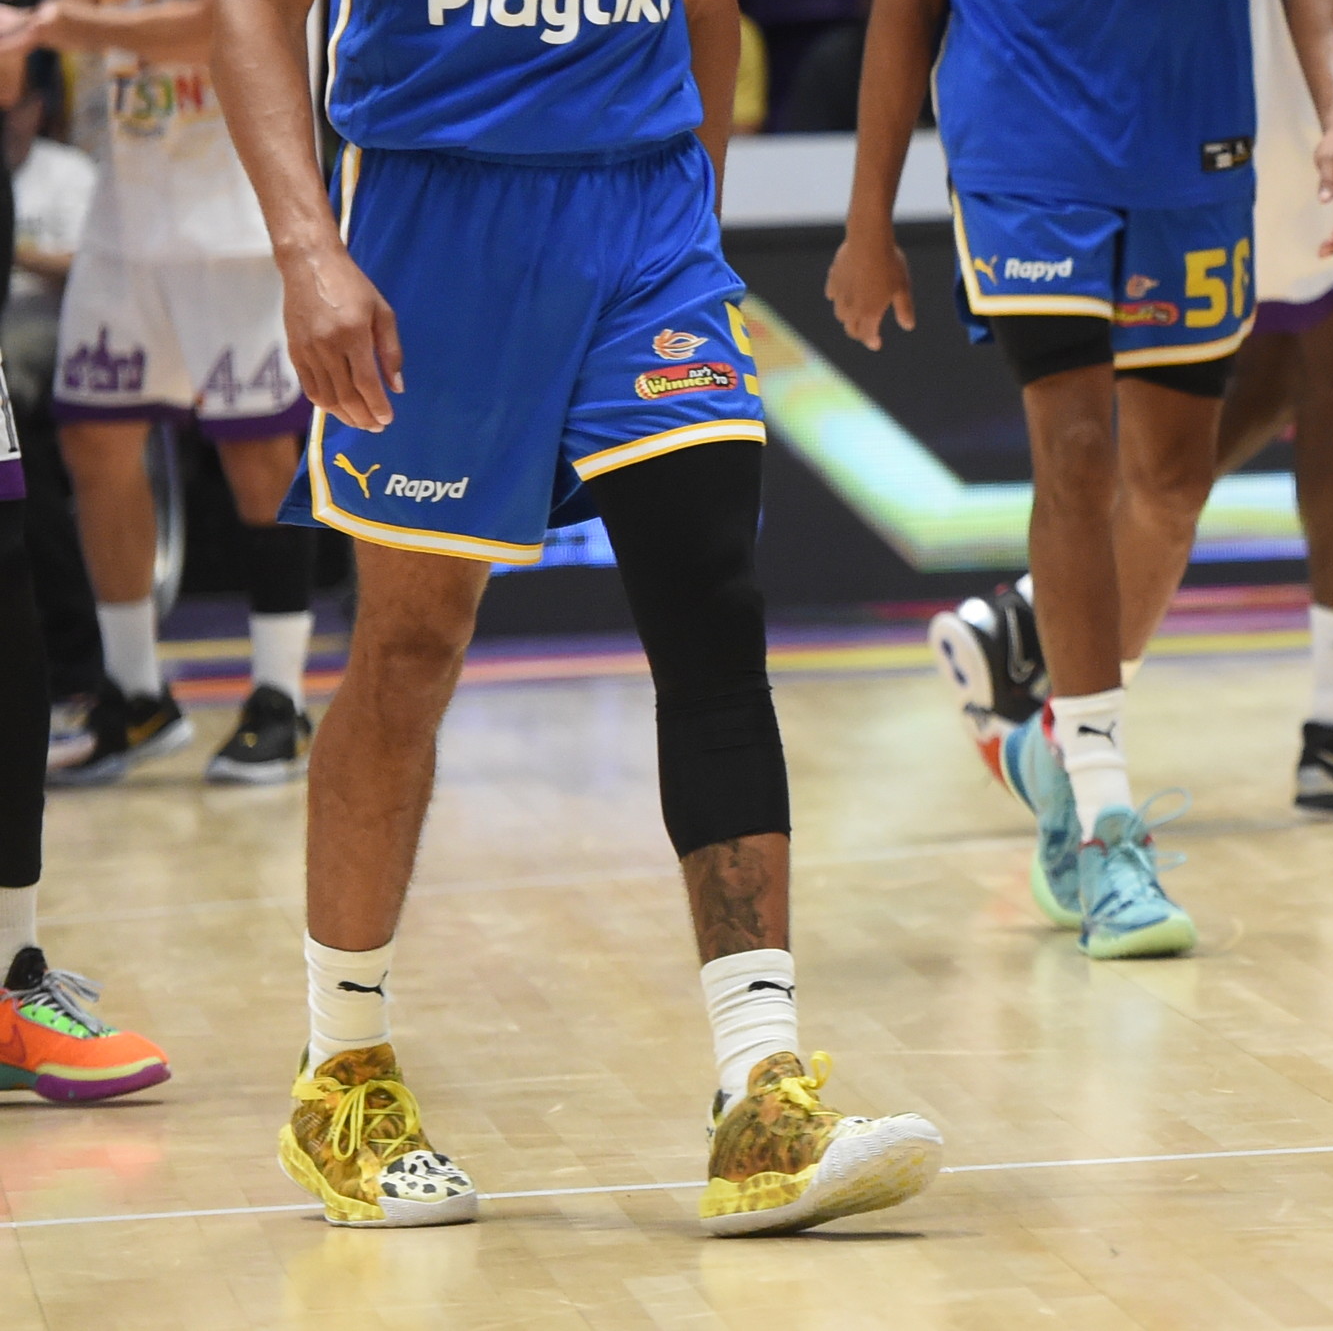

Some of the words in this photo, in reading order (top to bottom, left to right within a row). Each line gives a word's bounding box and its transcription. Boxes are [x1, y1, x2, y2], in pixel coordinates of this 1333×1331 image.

[1004, 257, 1074, 282] Rapyd
[205, 341, 291, 406] 44
[646, 375, 714, 394] Winner
[384, 473, 470, 503] Rapyd
